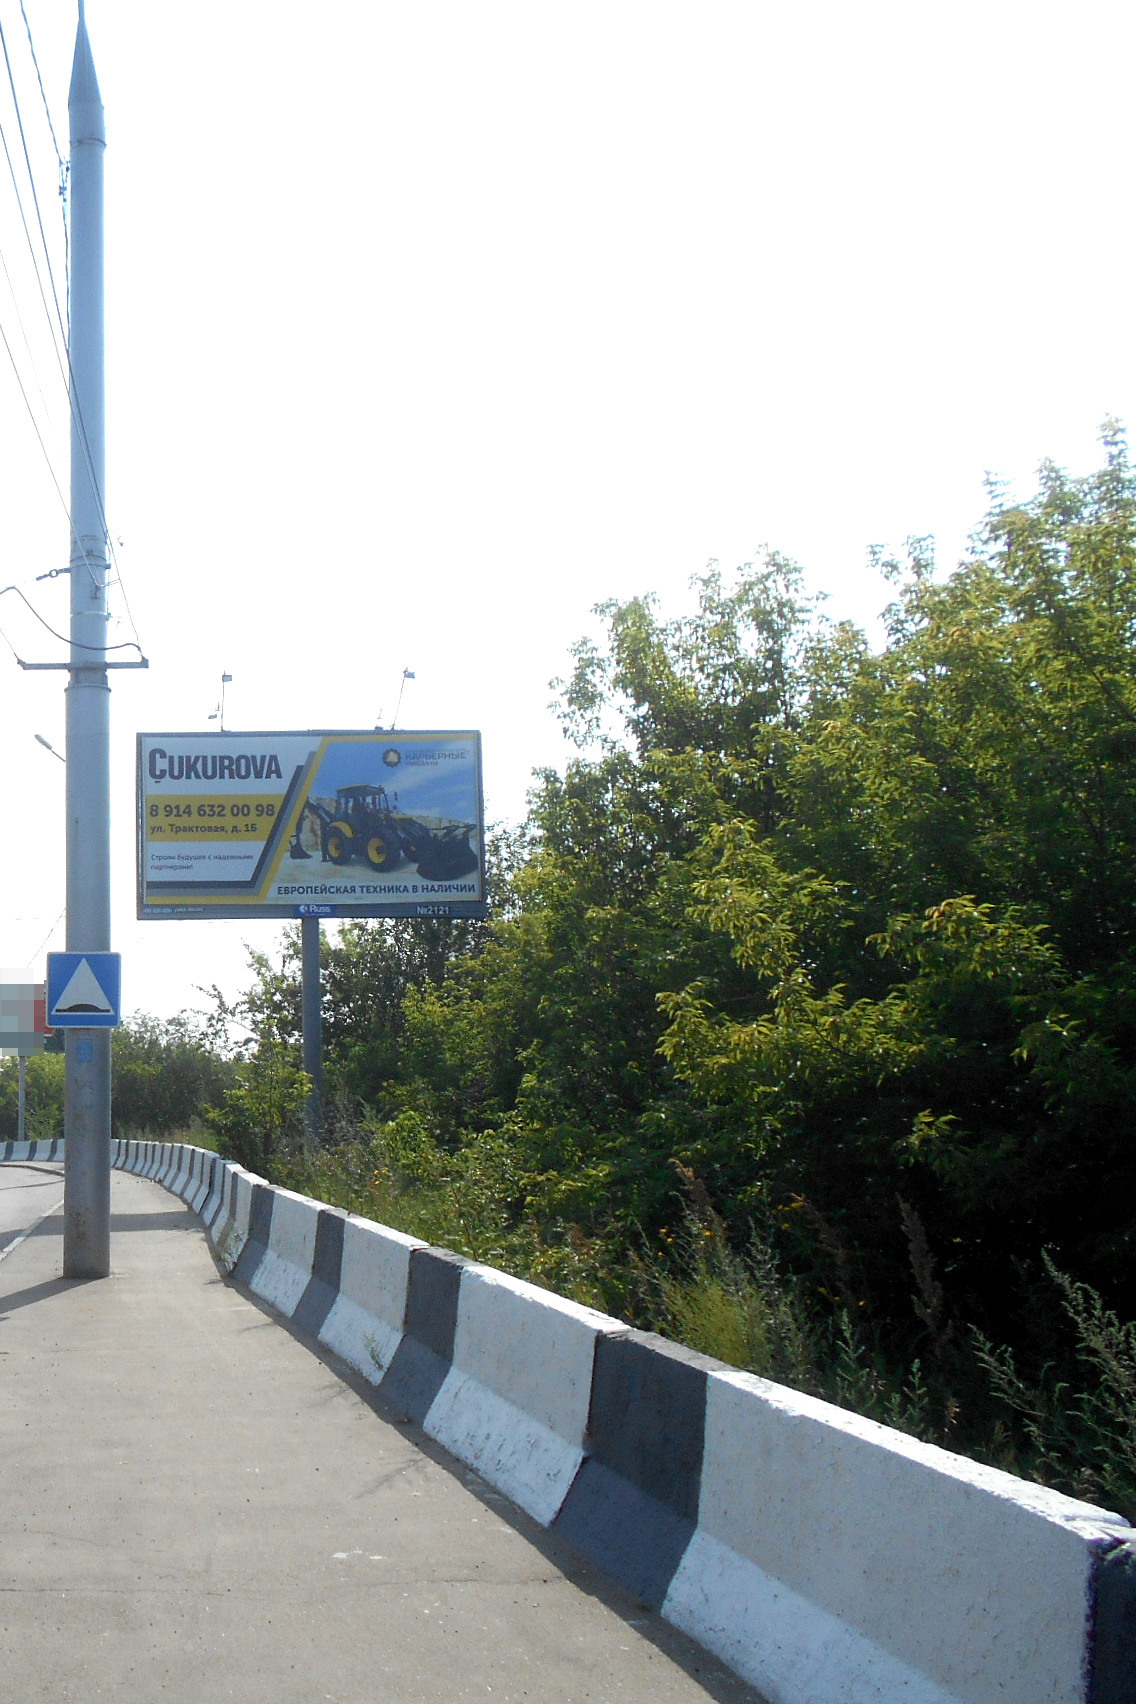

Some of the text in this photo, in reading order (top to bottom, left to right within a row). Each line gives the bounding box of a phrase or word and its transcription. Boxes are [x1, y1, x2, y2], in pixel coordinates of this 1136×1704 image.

[149, 804, 275, 817] 8 914 632 00 98
[150, 825, 166, 834] ул.
[169, 823, 228, 833] Трактовая,
[231, 824, 241, 833] д.
[277, 883, 476, 895] ЕВРОПЕЙСКАЯ ТЕХНИКА В НАЛИЧИИ
[416, 906, 449, 915] №2121
